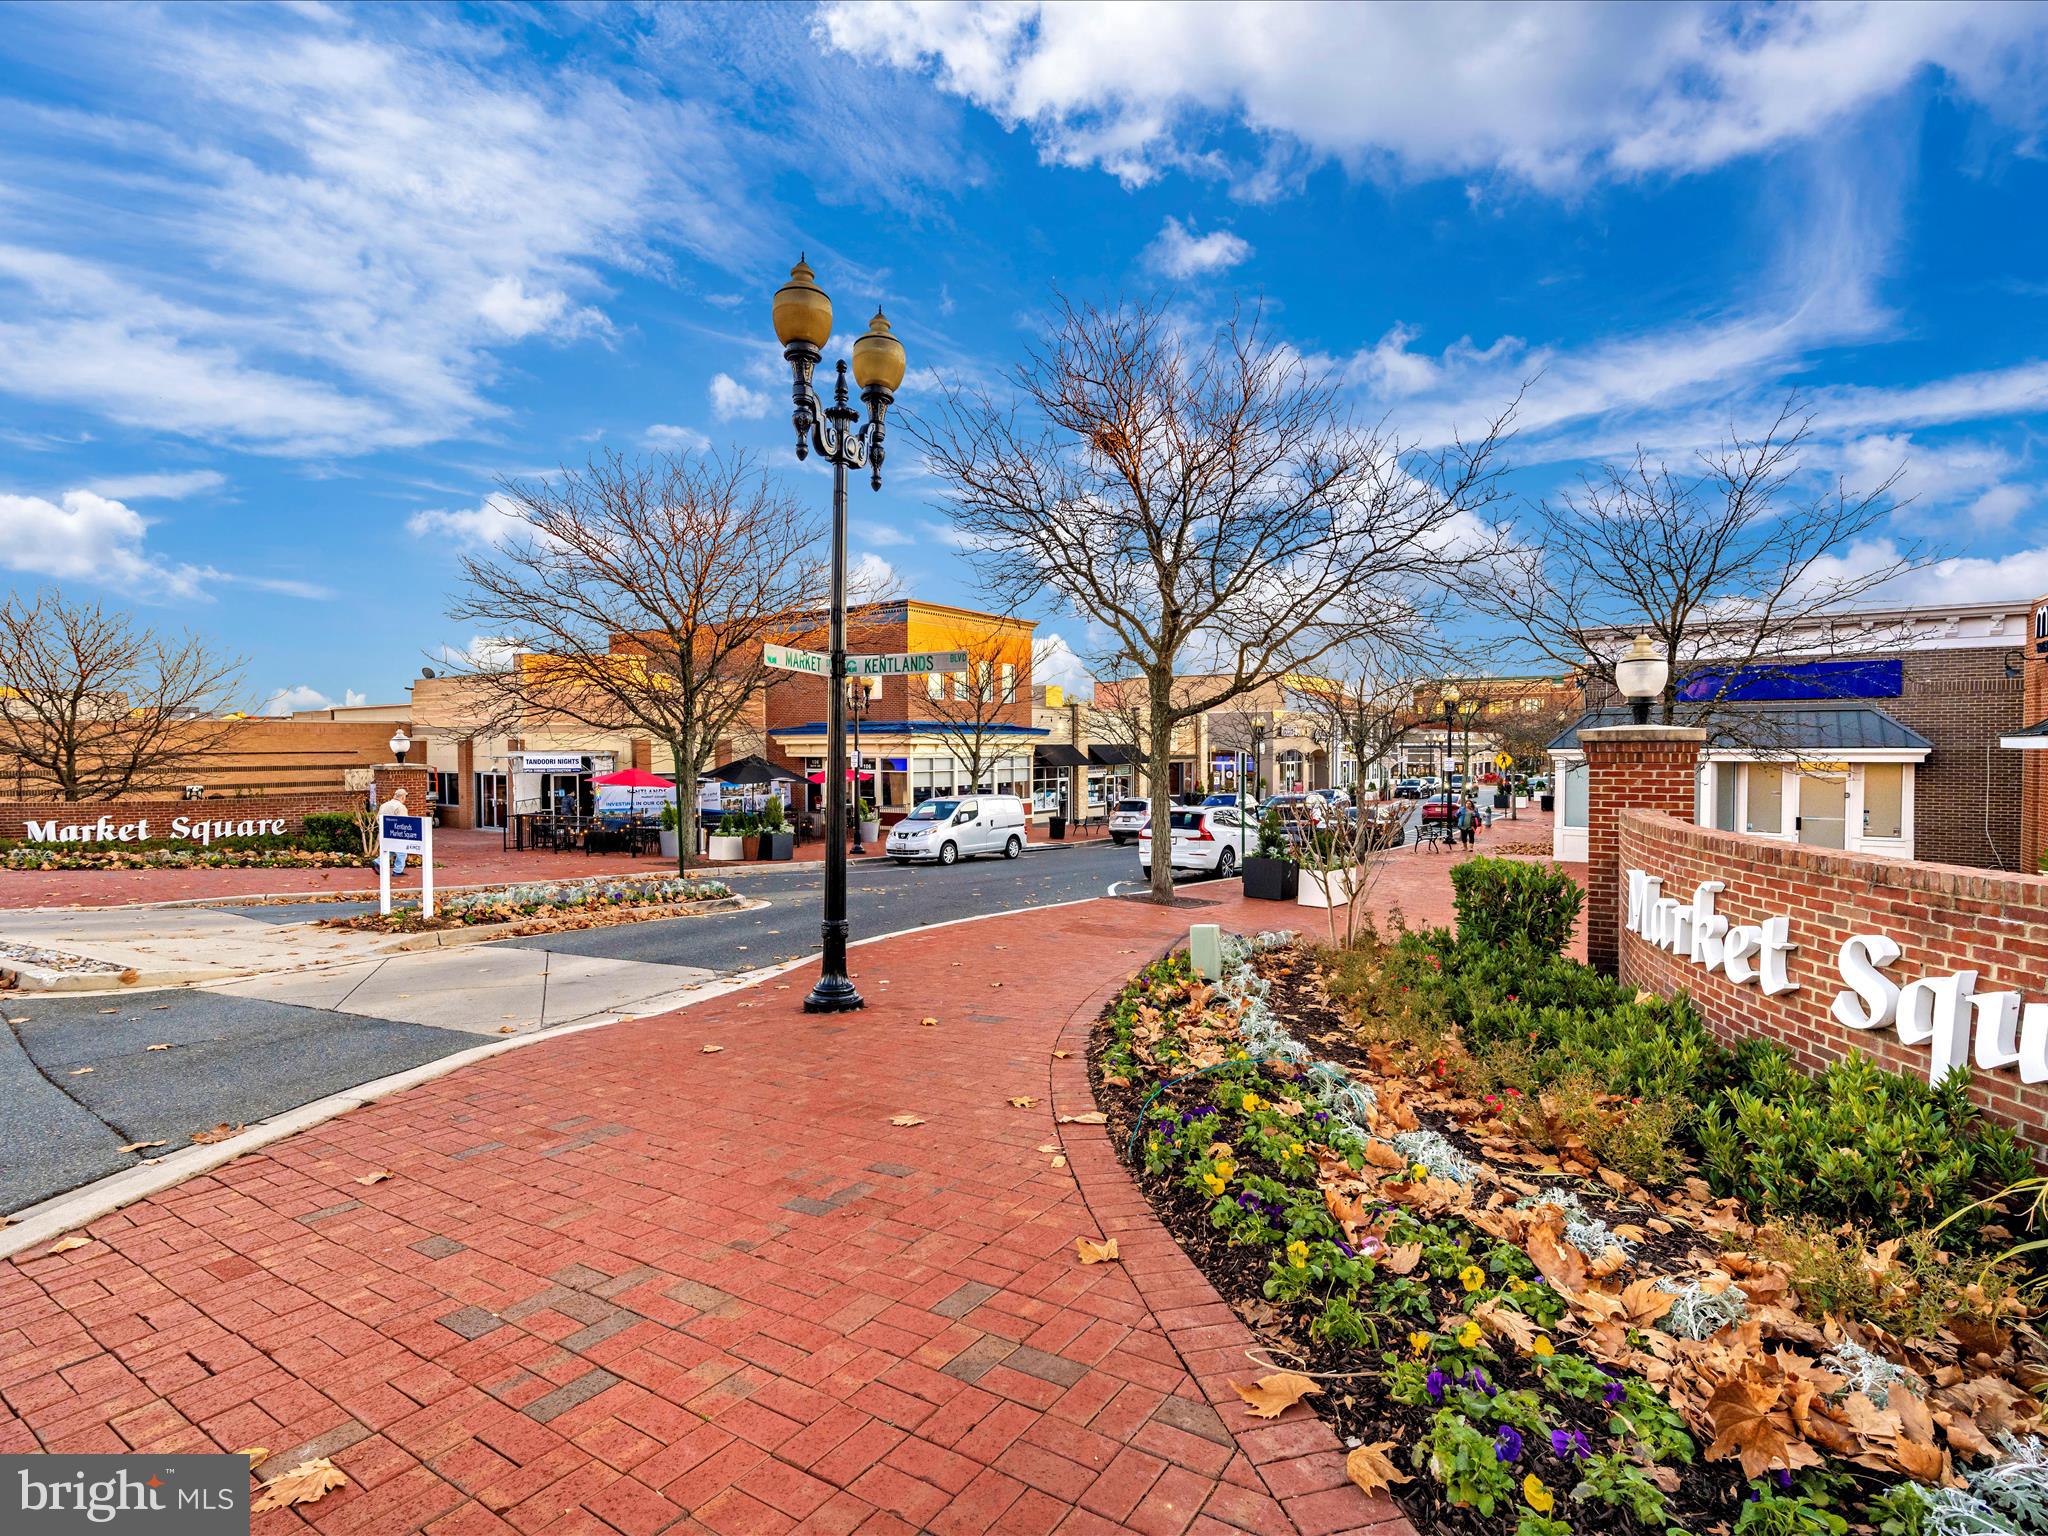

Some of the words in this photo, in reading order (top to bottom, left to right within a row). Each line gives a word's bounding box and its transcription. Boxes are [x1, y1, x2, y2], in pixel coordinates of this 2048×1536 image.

[785, 651, 822, 672] MARKET
[864, 655, 934, 674] KENTLANDS
[949, 653, 967, 663] BLVD
[22, 815, 151, 843] Market
[170, 816, 288, 846] Square
[404, 831, 417, 839] Square
[1626, 869, 1800, 996] Market
